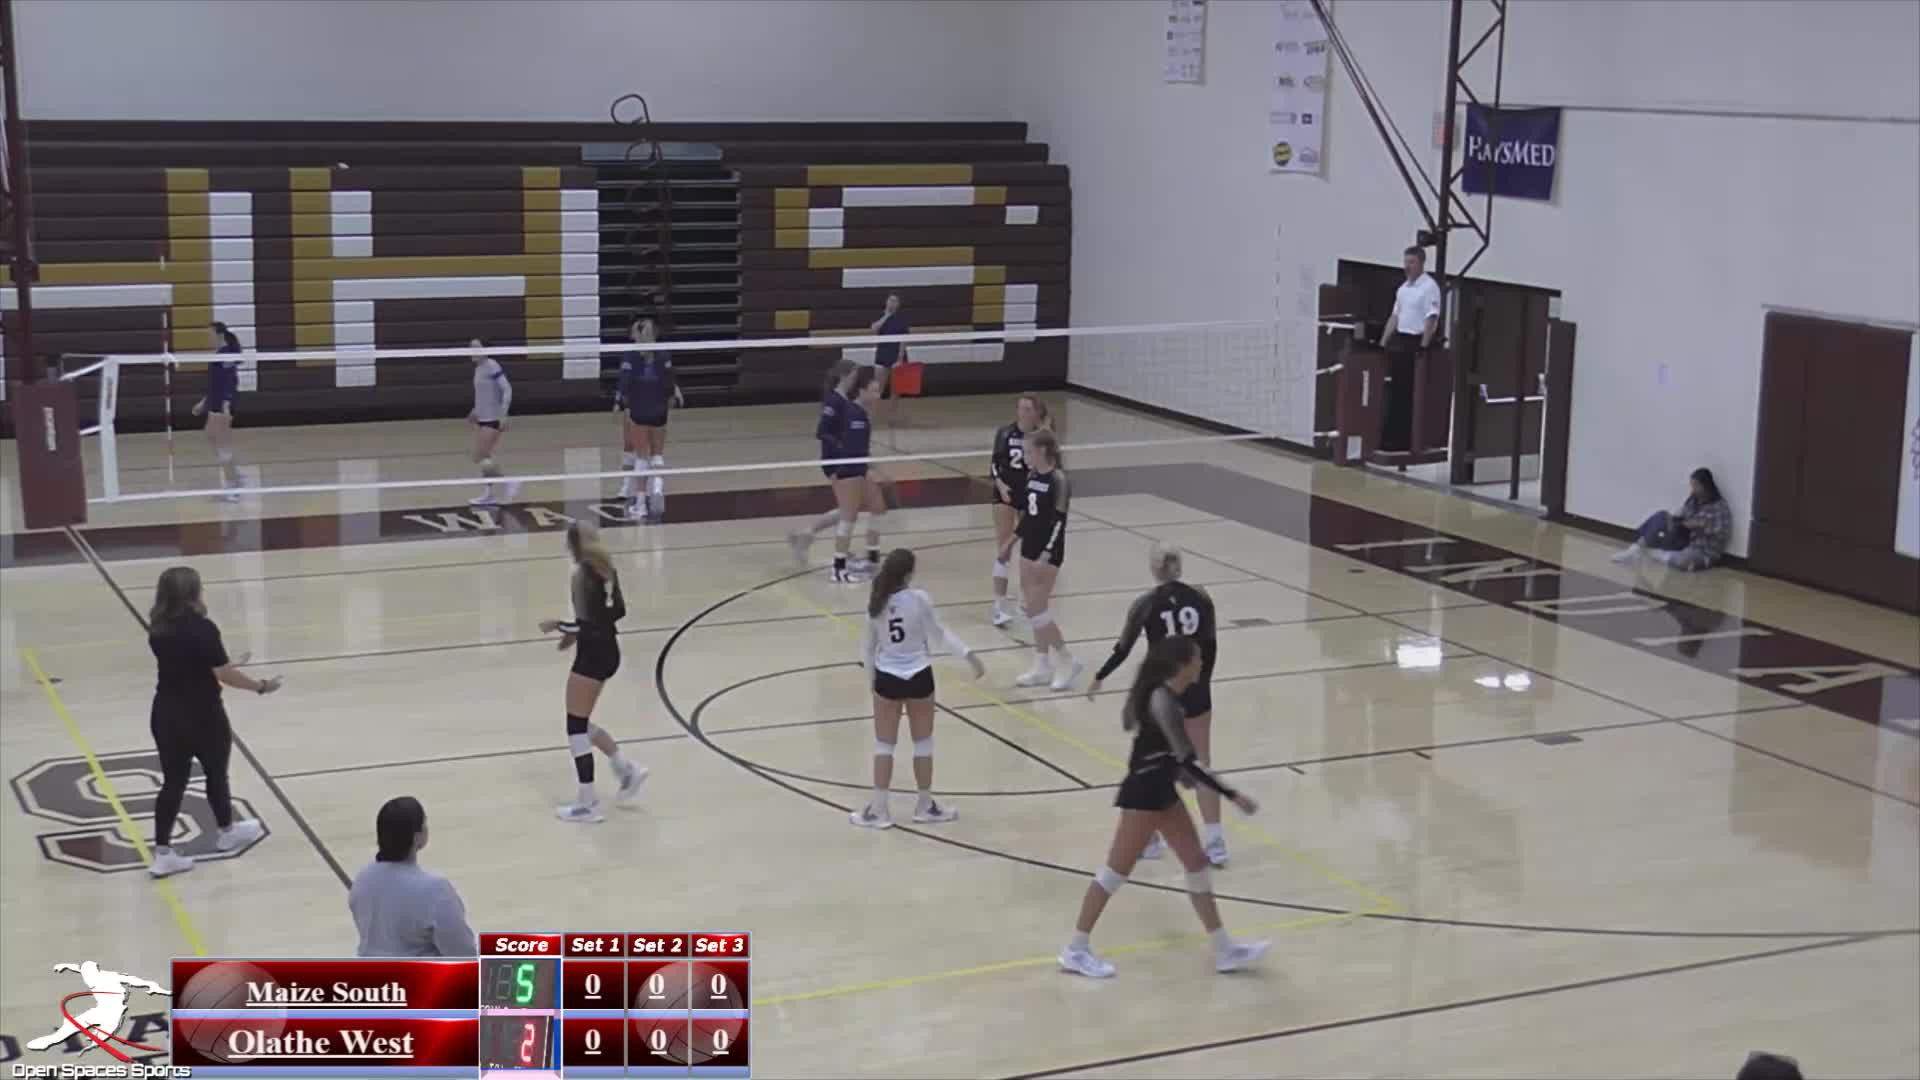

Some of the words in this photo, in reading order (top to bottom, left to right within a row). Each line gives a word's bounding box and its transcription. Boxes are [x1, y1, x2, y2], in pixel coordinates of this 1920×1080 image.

[888, 617, 905, 643] 5
[1160, 606, 1199, 637] 19
[1332, 537, 1920, 727] INDIA
